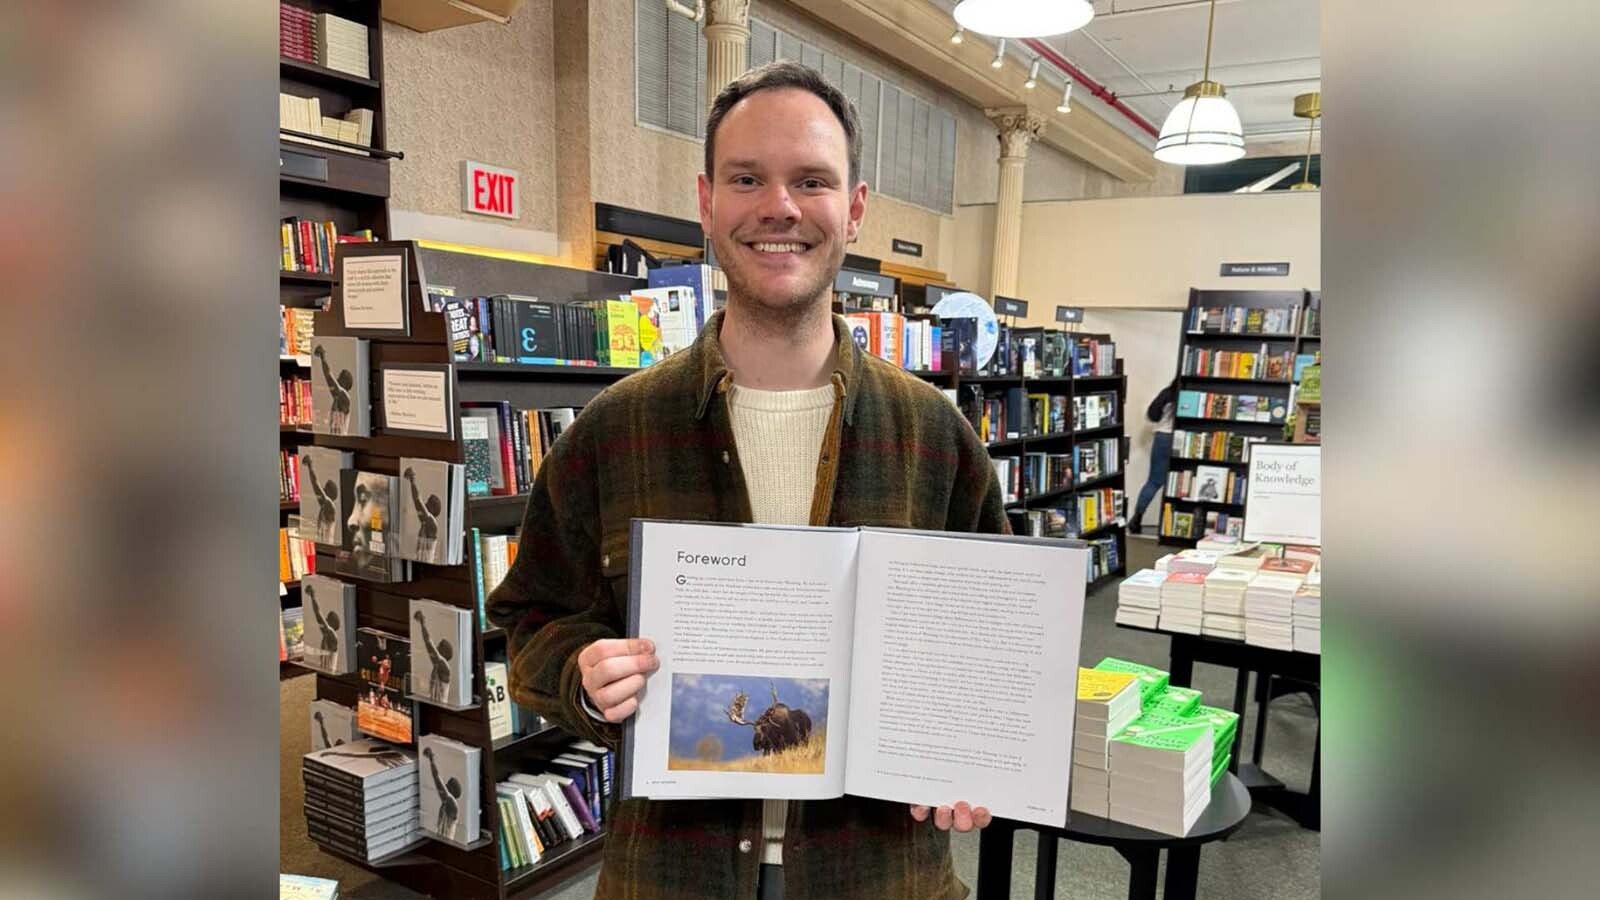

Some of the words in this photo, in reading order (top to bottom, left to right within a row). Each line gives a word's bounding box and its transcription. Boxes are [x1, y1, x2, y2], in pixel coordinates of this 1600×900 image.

[474, 169, 514, 214] EXIT
[1256, 460, 1281, 473] Body
[1286, 461, 1299, 471] of
[1255, 473, 1315, 486] Knowledge
[677, 551, 747, 567] Foreword
